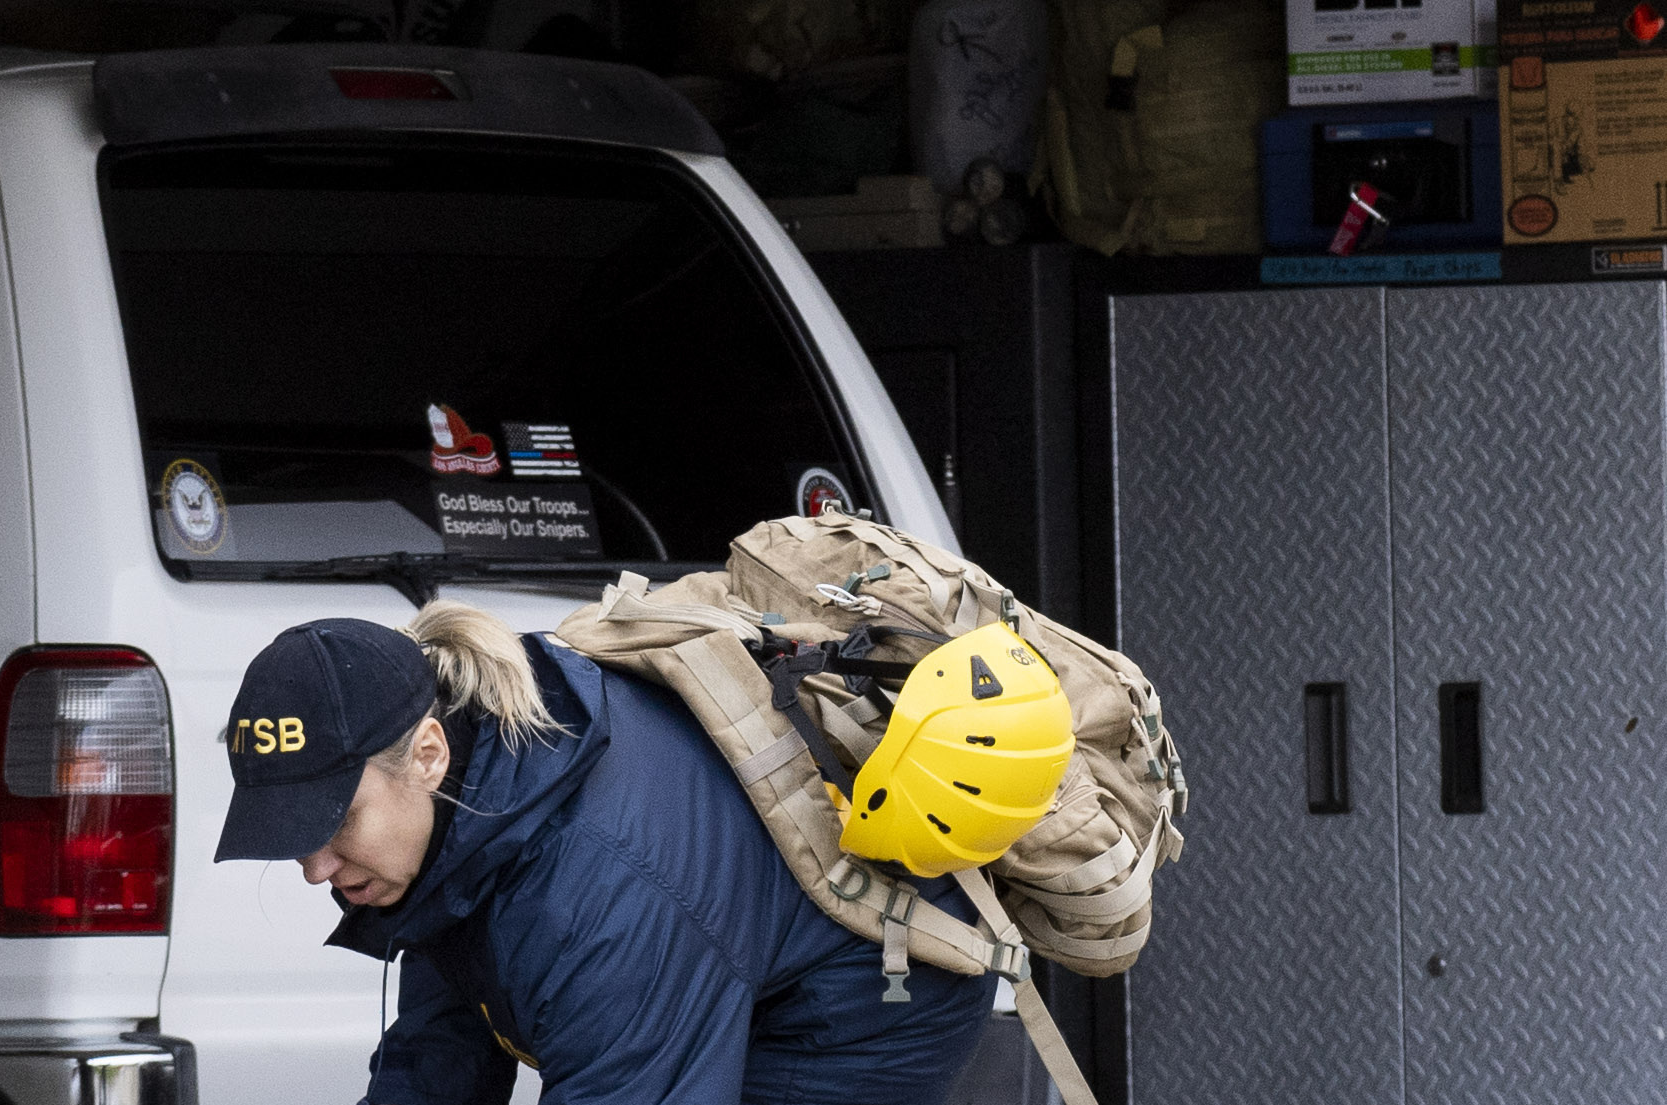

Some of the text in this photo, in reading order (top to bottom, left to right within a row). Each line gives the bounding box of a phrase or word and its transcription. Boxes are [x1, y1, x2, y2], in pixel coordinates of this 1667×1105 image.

[438, 493, 590, 518] God Bless Our Troops...
[442, 516, 590, 542] Especially Our Snipers.
